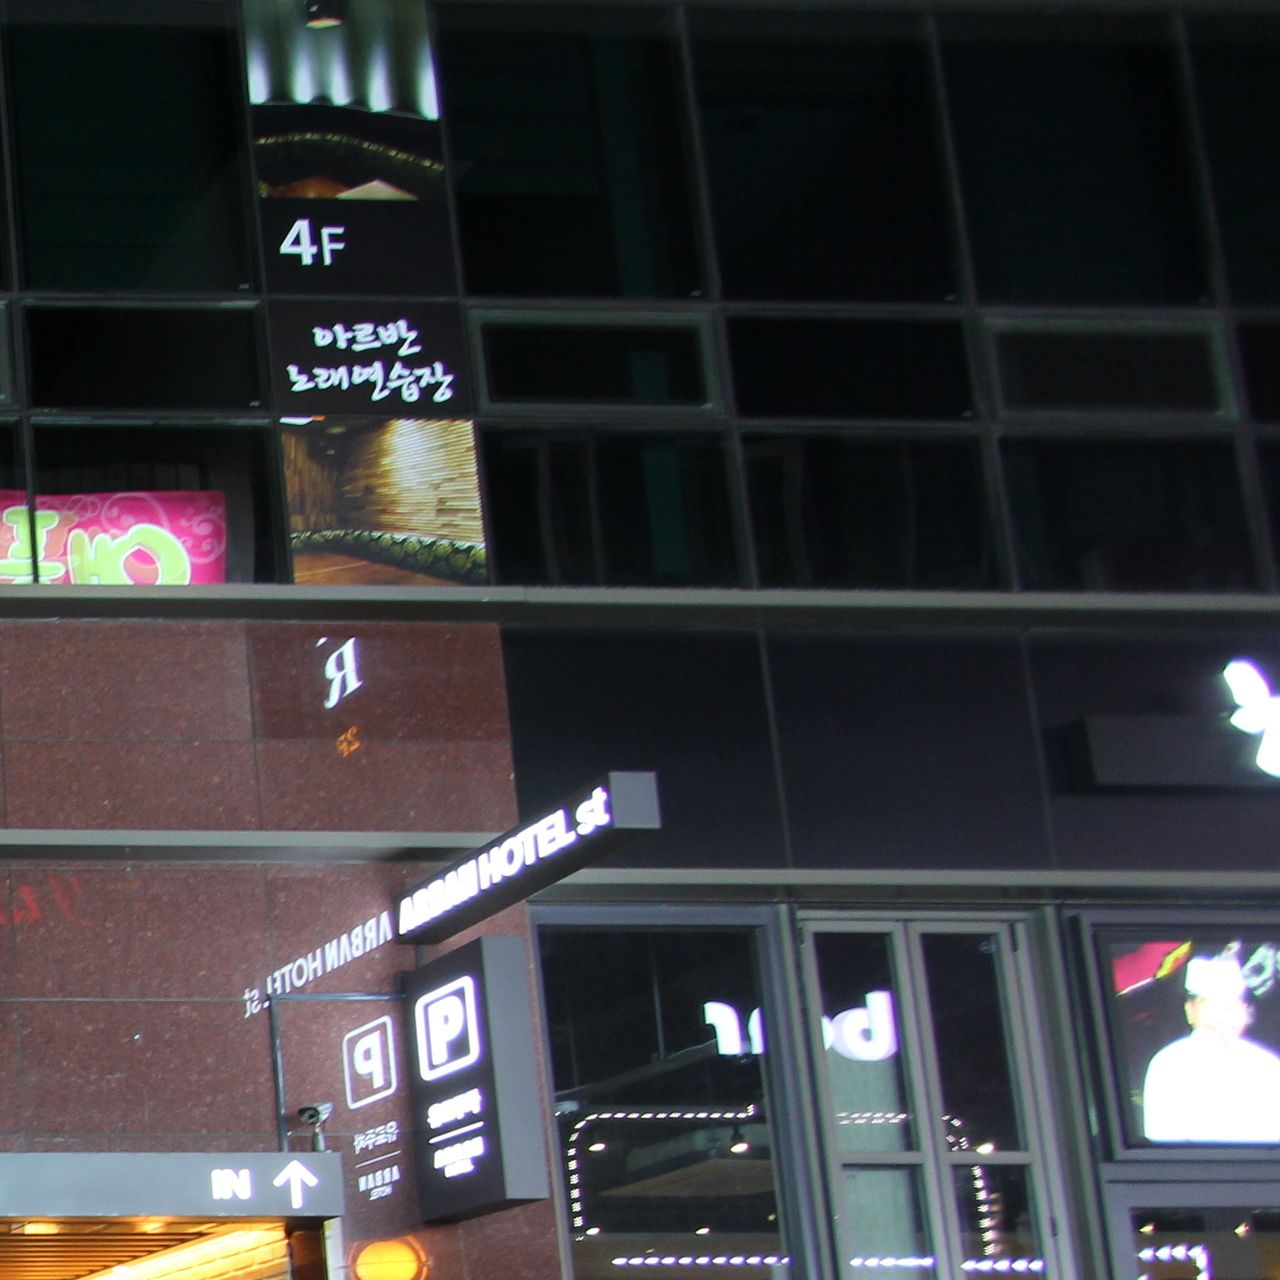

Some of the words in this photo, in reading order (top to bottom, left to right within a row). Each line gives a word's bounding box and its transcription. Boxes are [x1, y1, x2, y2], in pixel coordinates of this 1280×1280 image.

[279, 219, 345, 266] 4F
[312, 319, 422, 357] 아르반
[287, 361, 454, 403] 노래연습장
[479, 809, 576, 891] HOTEL
[576, 786, 611, 836] st
[426, 995, 465, 1066] P
[211, 1167, 252, 1201] IN
